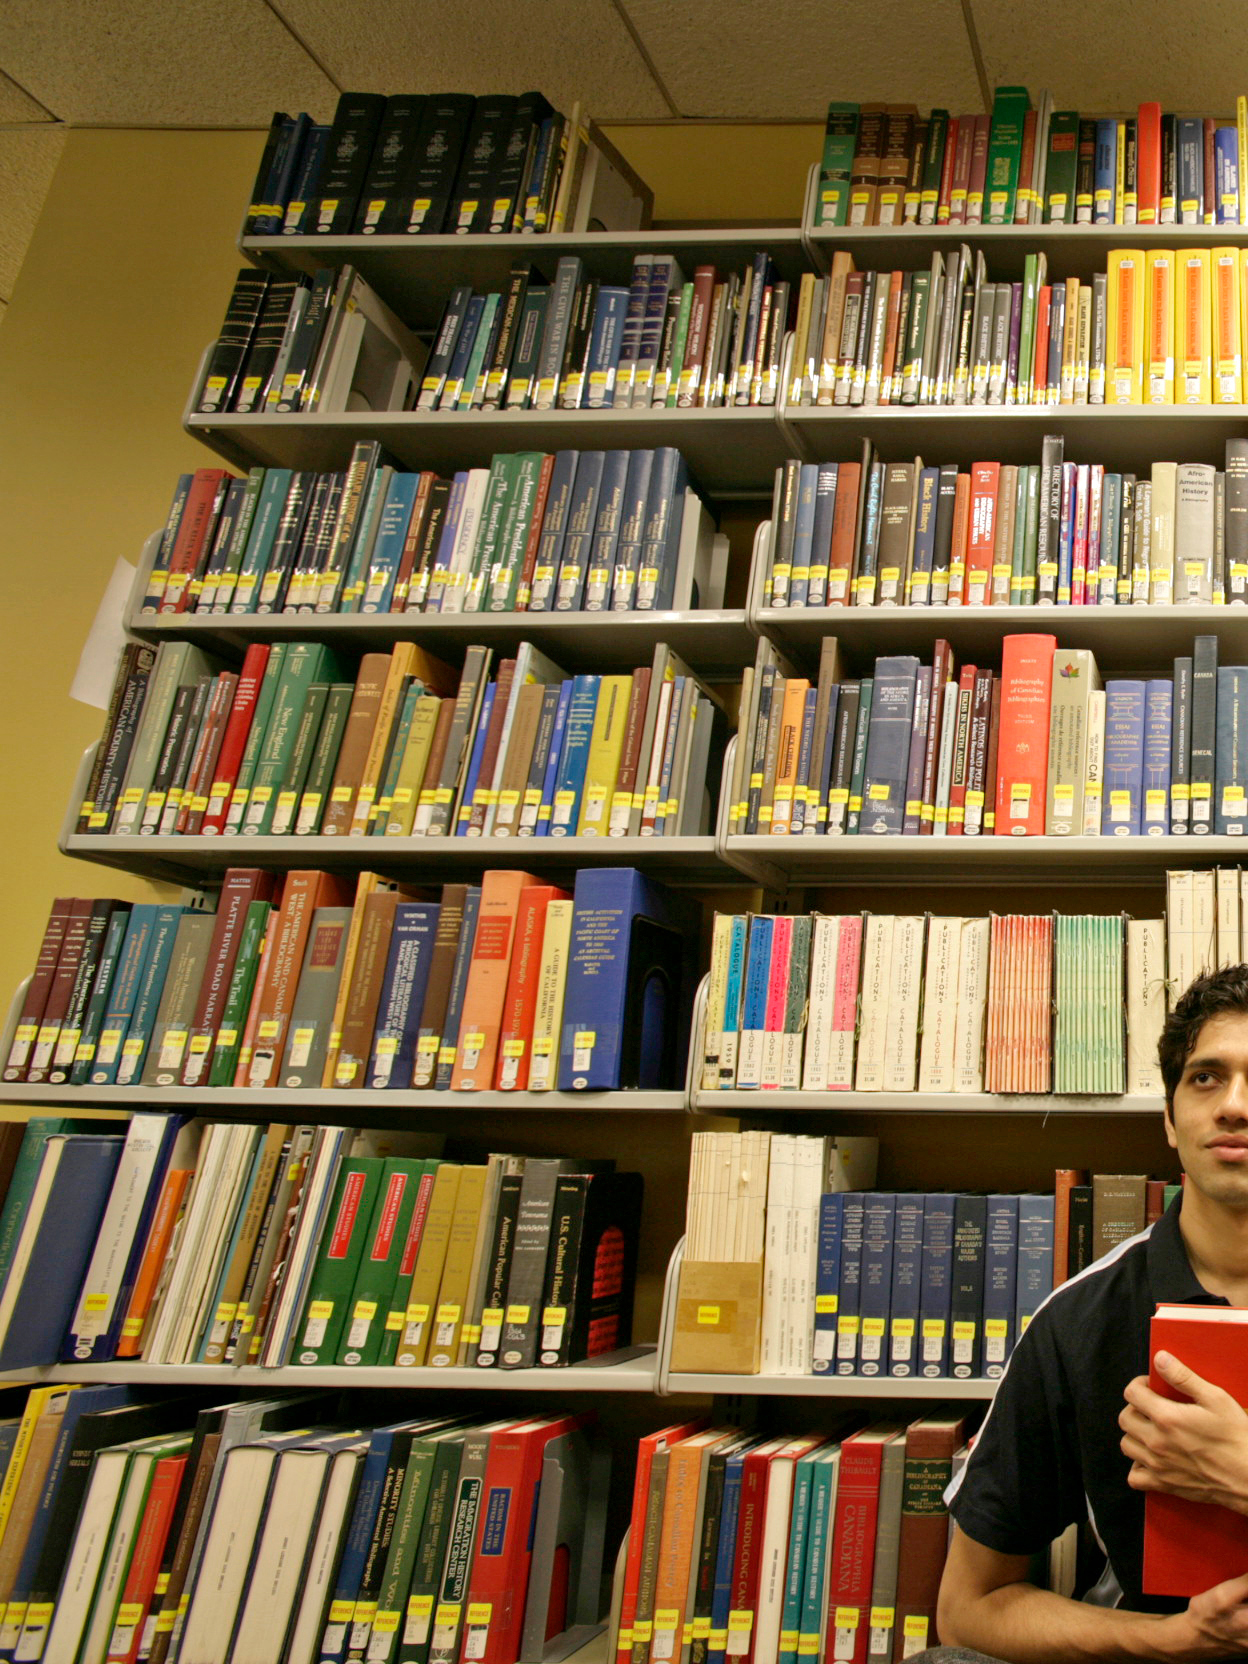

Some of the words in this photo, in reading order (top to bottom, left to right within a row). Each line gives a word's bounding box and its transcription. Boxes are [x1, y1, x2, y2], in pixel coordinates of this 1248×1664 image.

[511, 278, 521, 294] THE
[560, 276, 570, 294] THE
[556, 297, 567, 319] CIVIL
[694, 303, 704, 331] WOODROW
[495, 295, 517, 365] MEXICAN-AMERICAN
[552, 322, 562, 342] WAR
[690, 333, 699, 355] WILSON
[550, 344, 558, 353] IN
[995, 334, 1003, 358] RHETORIC
[546, 356, 556, 375] BOO
[352, 460, 367, 494] MILITARY
[495, 480, 507, 499] The
[923, 477, 933, 500] Black
[1051, 466, 1060, 507] DIRECTORY
[345, 494, 359, 525] HISTORY
[517, 479, 533, 521] American
[1039, 465, 1050, 526] AFRO-AMERICAN
[486, 501, 502, 543] American
[918, 502, 930, 533] History
[978, 497, 986, 534] DEMOGRAPHY
[1050, 509, 1058, 520] OF
[480, 544, 493, 572] Presid
[507, 522, 525, 566] Presidents
[1038, 529, 1047, 558] RESOU
[116, 680, 136, 728] AMERICAN
[127, 687, 143, 725] Bibliography
[280, 706, 292, 728] New
[858, 706, 866, 732] American
[960, 713, 966, 721] IN
[170, 713, 182, 738] Historic
[788, 725, 796, 745] BLACK
[840, 710, 849, 749] AFRO-AMERICAN
[958, 723, 966, 747] NORTH
[977, 716, 985, 748] LATINOS
[105, 727, 123, 768] COUNTY
[159, 738, 175, 775] Preservation
[270, 727, 287, 760] England
[856, 734, 864, 751] Black
[837, 750, 845, 776] RELIGIOUS
[854, 752, 862, 774] Women
[955, 749, 963, 782] AMERICA
[975, 750, 983, 766] AND
[974, 768, 982, 792] POLIT
[225, 895, 241, 930] PLATTE
[295, 892, 305, 910] THE
[85, 939, 92, 947] in
[218, 931, 232, 961] RIVER
[286, 910, 302, 954] AMERICAN
[82, 947, 90, 958] the
[270, 926, 289, 988] BIBLIOGRAPHY
[281, 956, 292, 975] AND
[516, 941, 530, 984] bibliography
[550, 954, 558, 975] GUIDE
[732, 927, 741, 974] CATALOGUE
[73, 958, 87, 992] Twentieth
[84, 963, 94, 978] The
[210, 962, 224, 990] ROAD
[233, 966, 245, 984] The
[544, 966, 551, 975] OF
[550, 978, 556, 986] TO
[75, 979, 90, 1011] American
[228, 985, 241, 1006] Trail
[271, 977, 288, 1021] CANADIAN
[539, 977, 550, 1019] CALIFORNIA
[199, 992, 217, 1036] NARRATI
[511, 999, 523, 1036] 1570-1970
[544, 1005, 553, 1036] HISTORY
[497, 1216, 511, 1256] American
[559, 1215, 569, 1235] U.S.
[554, 1237, 567, 1274] Cultural
[491, 1258, 505, 1289] Popular
[549, 1275, 562, 1308] History
[677, 1460, 689, 1486] Index
[380, 1474, 392, 1504] Selective
[389, 1468, 404, 1511] MINORITY
[469, 1482, 479, 1499] THE
[676, 1489, 684, 1499] to
[398, 1470, 421, 1544] Minorities
[453, 1499, 467, 1543] RESEARCH
[489, 1493, 498, 1523] UNITED
[496, 1493, 506, 1521] RACISM
[372, 1506, 386, 1541] Annotated
[459, 1500, 476, 1559] IMMIGRATION
[485, 1525, 494, 1550] STATES
[495, 1523, 501, 1531] IN
[670, 1502, 684, 1551] Canadian
[740, 1505, 753, 1578] INTRODUCING
[838, 1505, 855, 1592] CANADIANA
[851, 1505, 866, 1592] BIBLIOGRAPHIA
[362, 1542, 378, 1588] Bibliography
[391, 1547, 404, 1576] and
[447, 1544, 460, 1578] CENTER
[666, 1553, 679, 1587] Poetry
[452, 1560, 465, 1598] HISTORY
[384, 1578, 397, 1611] Wo
[737, 1582, 747, 1610] CANA
